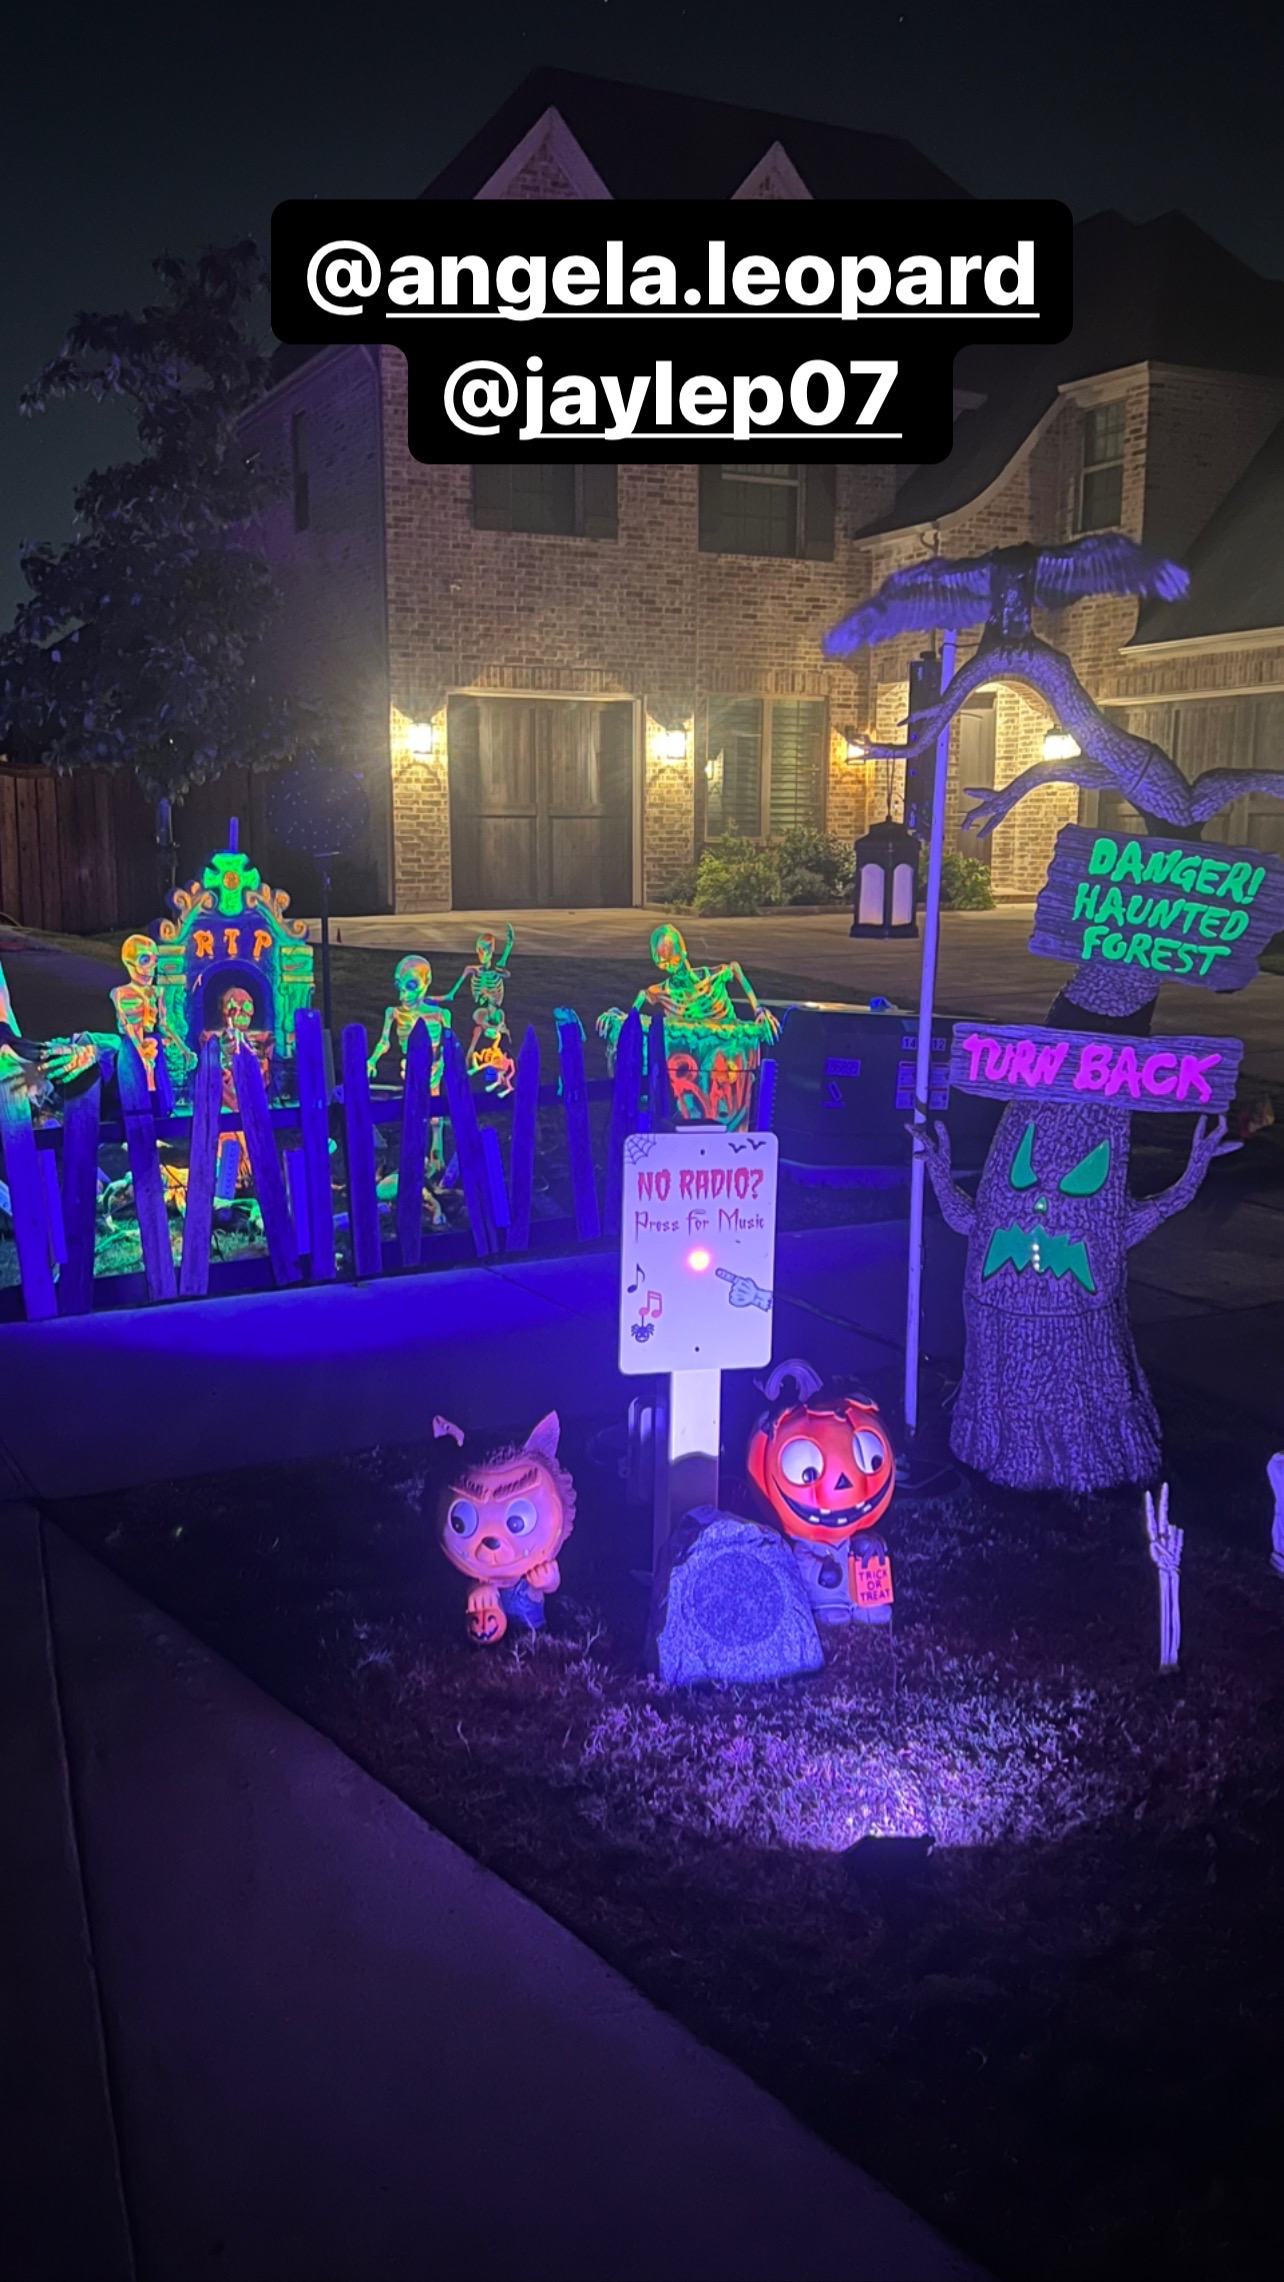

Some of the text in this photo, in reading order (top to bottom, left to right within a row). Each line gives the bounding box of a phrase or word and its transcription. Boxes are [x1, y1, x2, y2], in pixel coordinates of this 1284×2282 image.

[1088, 838, 1266, 905] DANGER!
[1072, 883, 1249, 941] HAUNTED
[1081, 926, 1232, 976] FOREST
[962, 1033, 1070, 1089] TURN
[1072, 1043, 1222, 1103] BACK
[637, 1167, 764, 1201] NO RADIO?
[634, 1207, 765, 1242] Press for Music
[858, 1569, 888, 1581] TRICK
[866, 1580, 883, 1591] OR
[860, 1588, 890, 1602] TREAT
